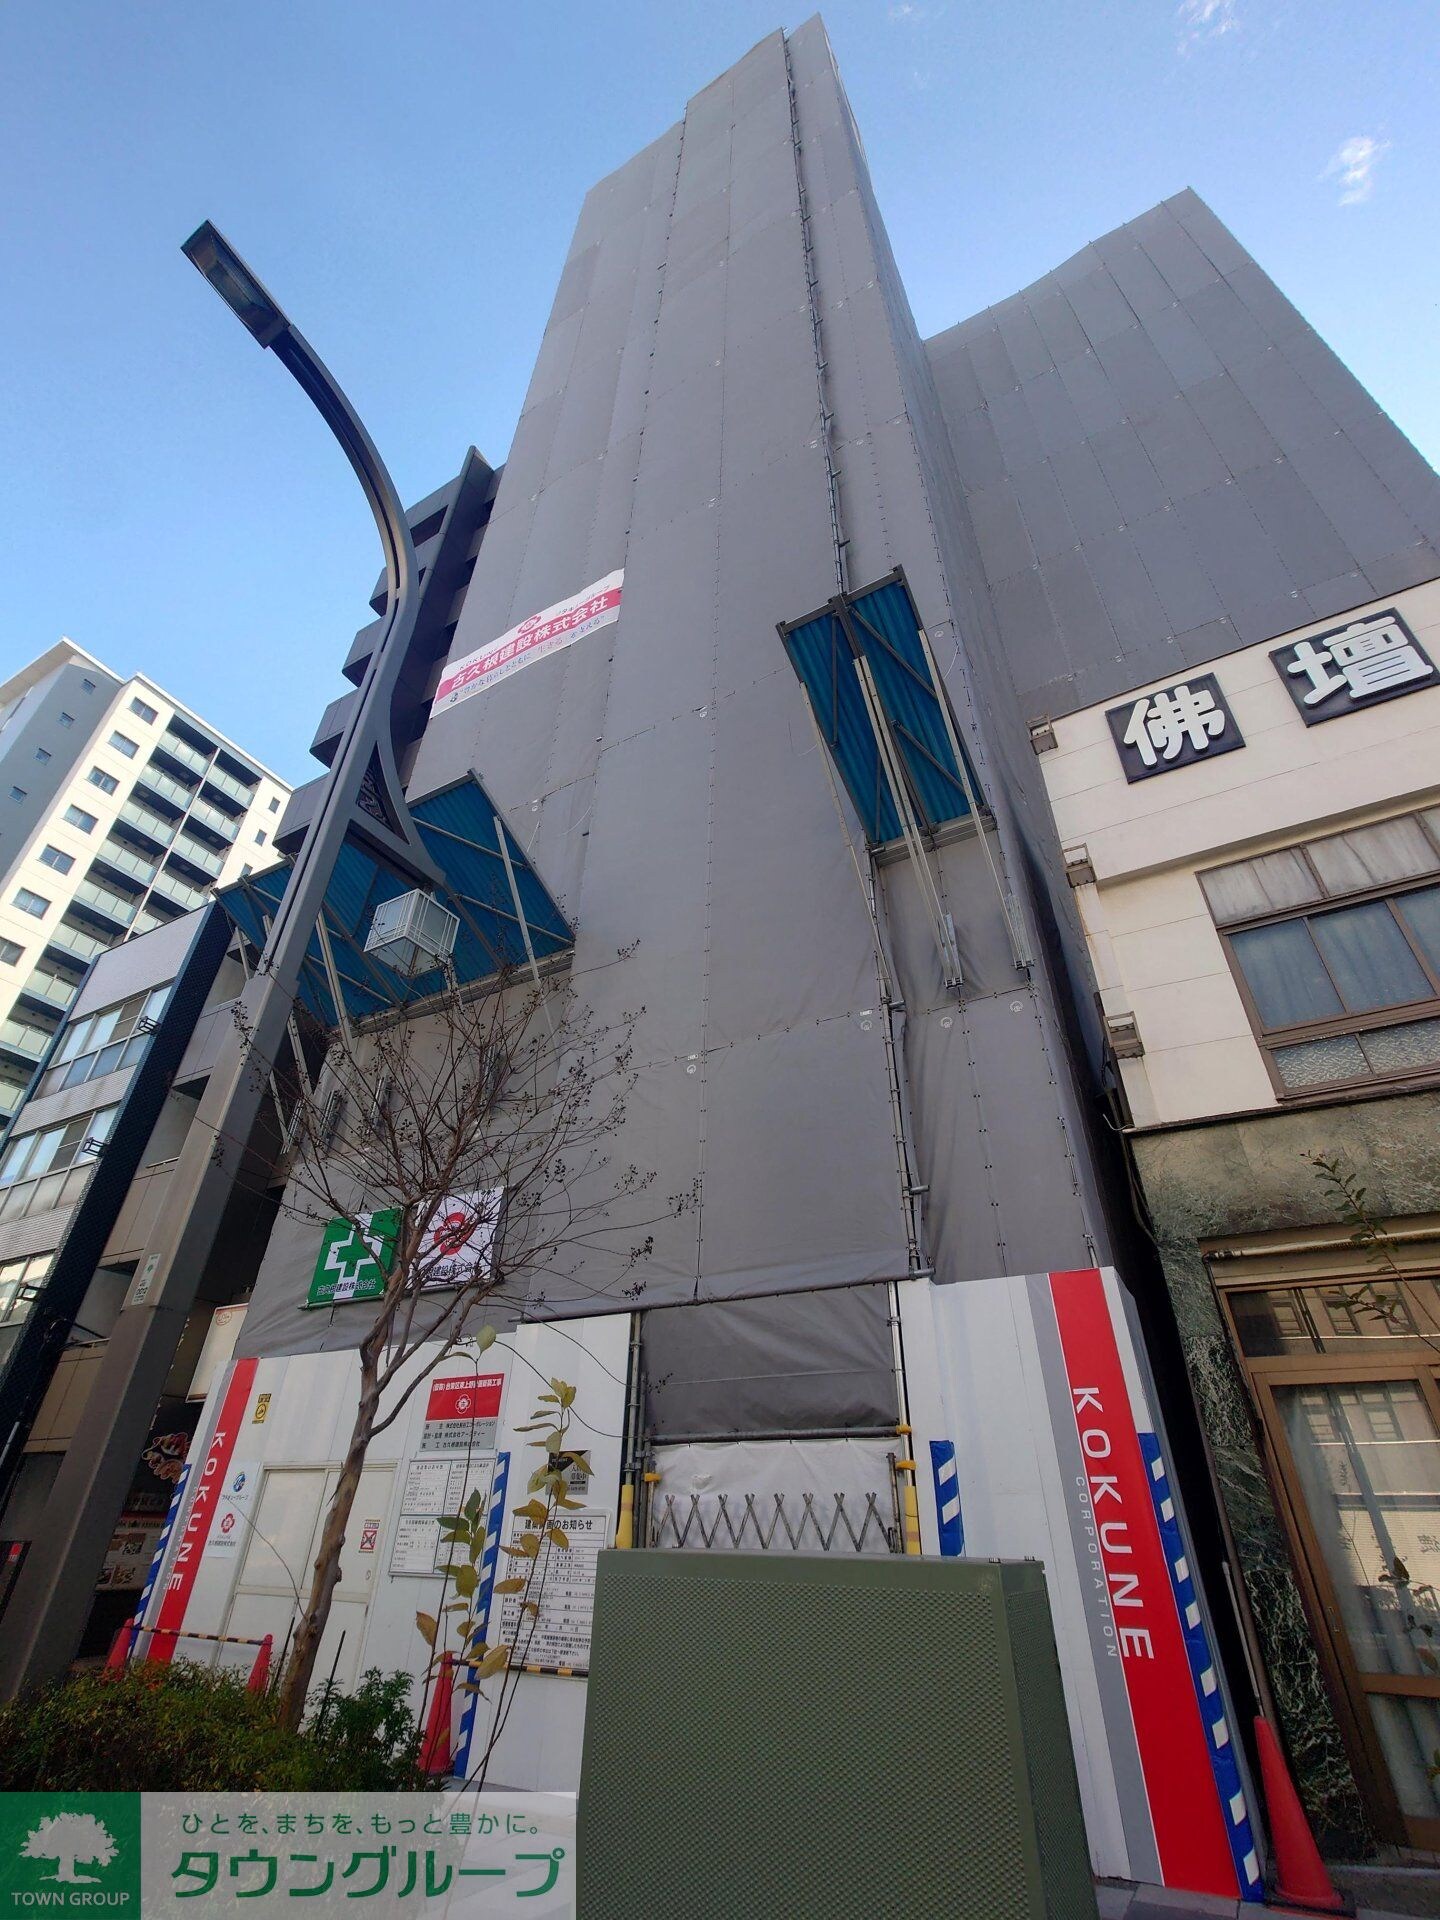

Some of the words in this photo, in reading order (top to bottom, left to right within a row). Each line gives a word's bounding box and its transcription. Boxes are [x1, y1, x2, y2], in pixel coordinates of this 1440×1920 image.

[451, 596, 609, 689] 古久根建設株式会社
[168, 1431, 226, 1592] KOKUNE
[1072, 1386, 1155, 1661] KOKUNE
[1075, 1476, 1118, 1658] CORPORATION
